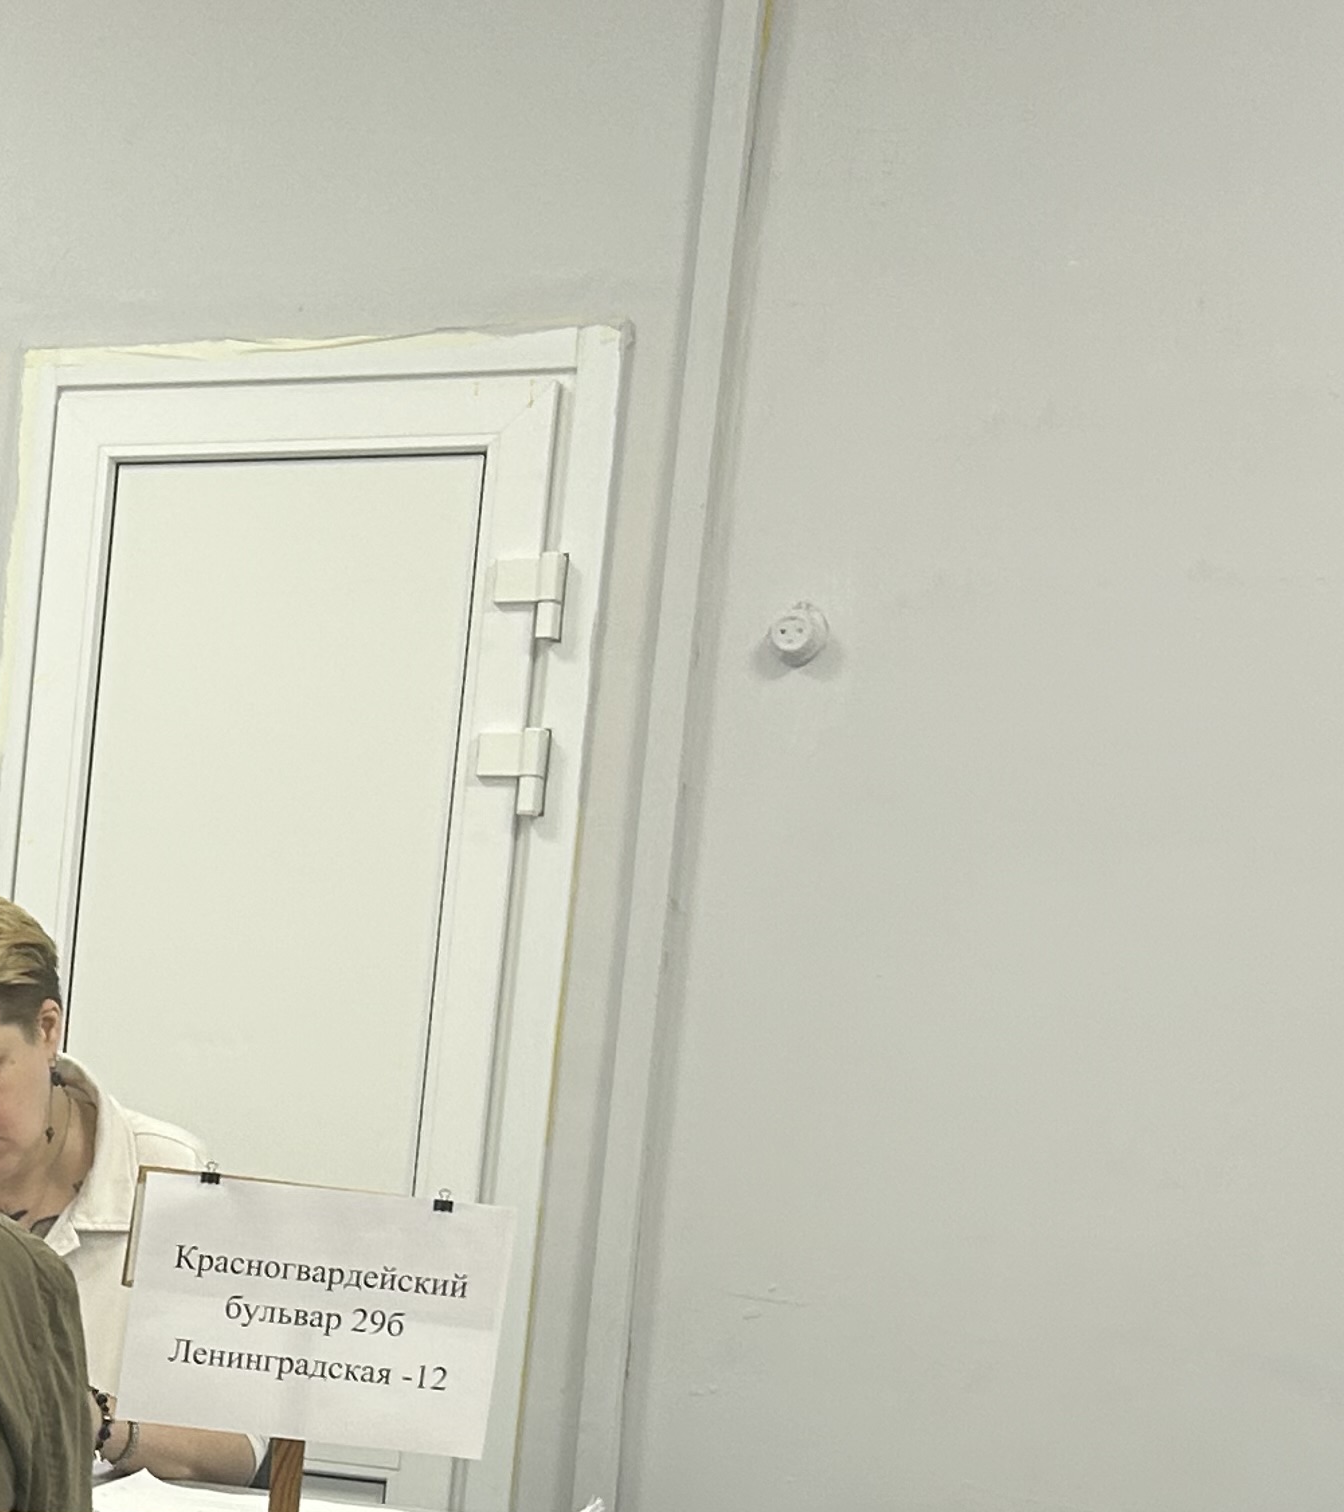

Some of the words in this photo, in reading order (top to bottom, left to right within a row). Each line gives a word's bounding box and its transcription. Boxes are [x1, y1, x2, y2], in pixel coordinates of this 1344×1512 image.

[174, 1244, 468, 1299] Красногвардейский
[225, 1295, 342, 1336] бульвар
[168, 1338, 391, 1386] Ленинградская
[401, 1365, 448, 1391] -12
